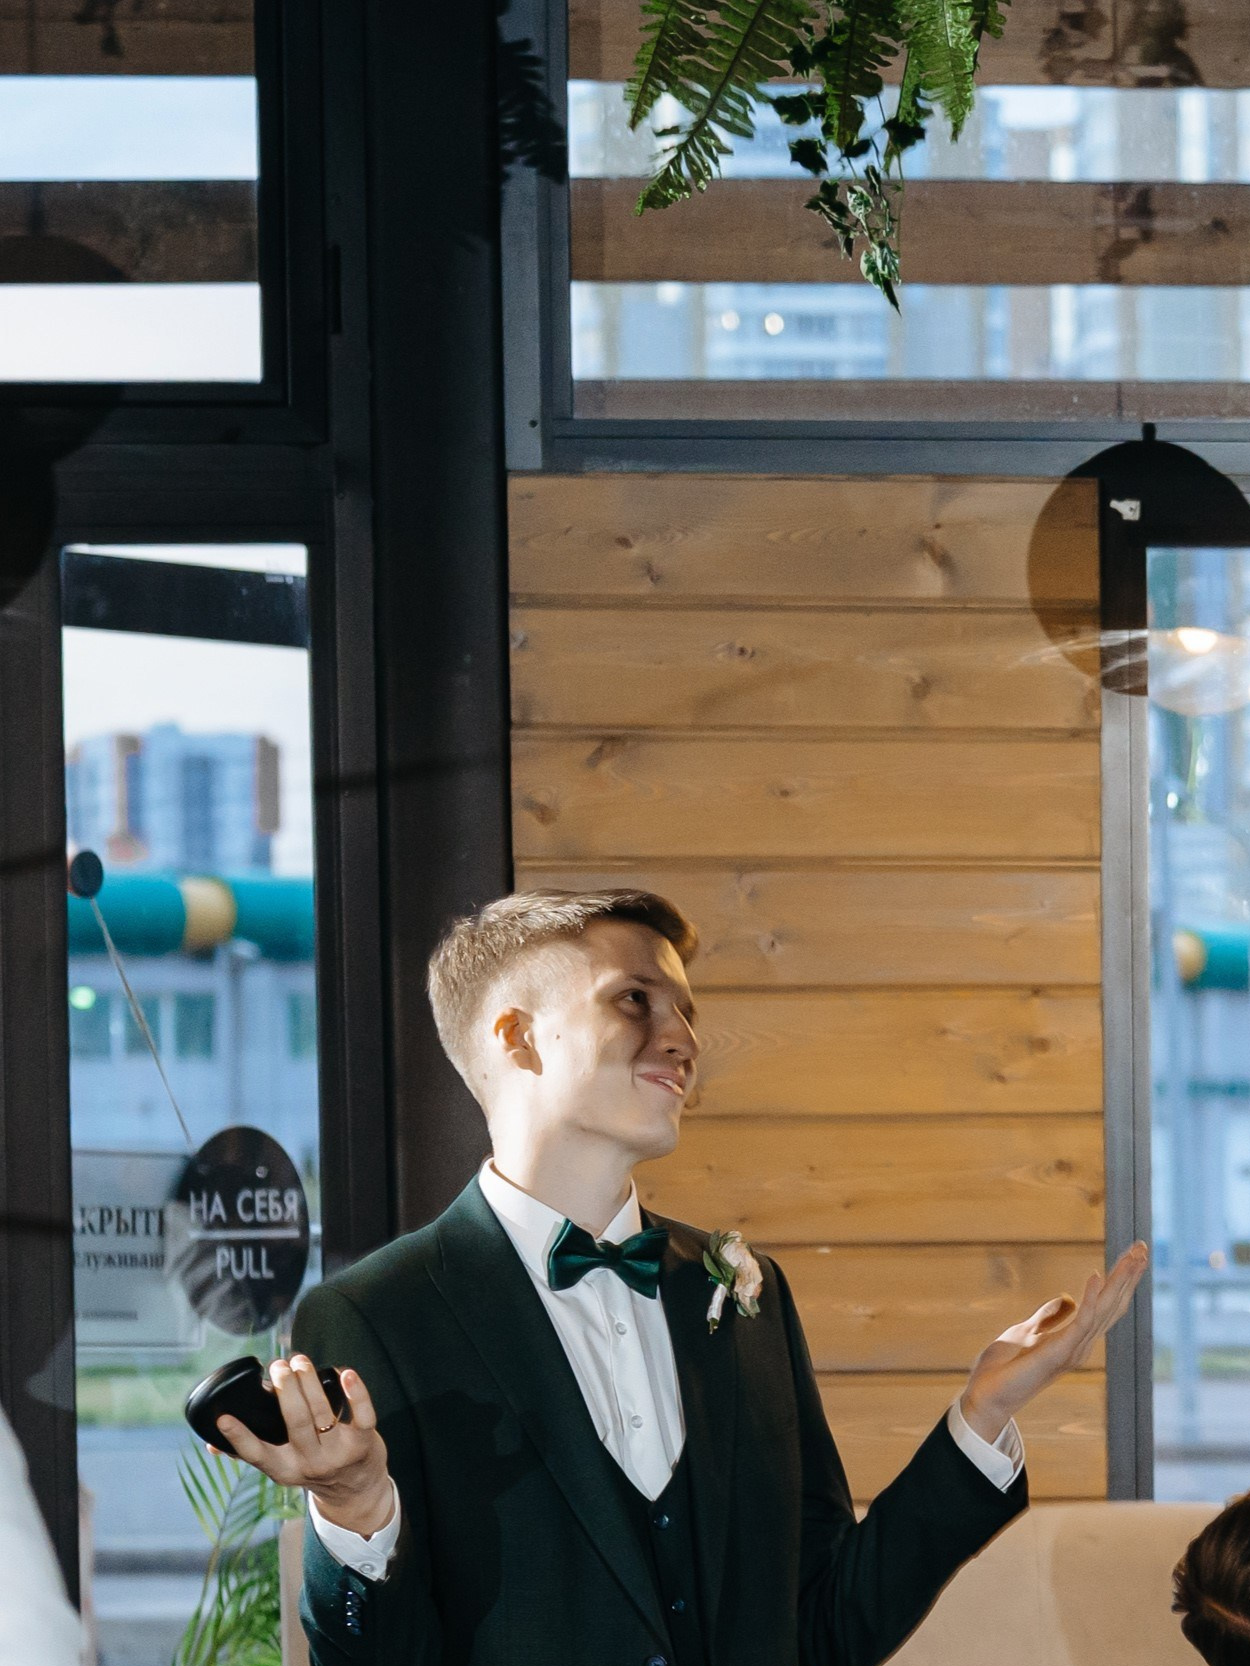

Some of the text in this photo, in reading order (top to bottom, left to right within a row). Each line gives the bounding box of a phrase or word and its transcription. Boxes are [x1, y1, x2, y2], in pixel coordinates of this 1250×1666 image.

[190, 1188, 298, 1223] НА СЕБЯ
[216, 1247, 275, 1280] PULL
